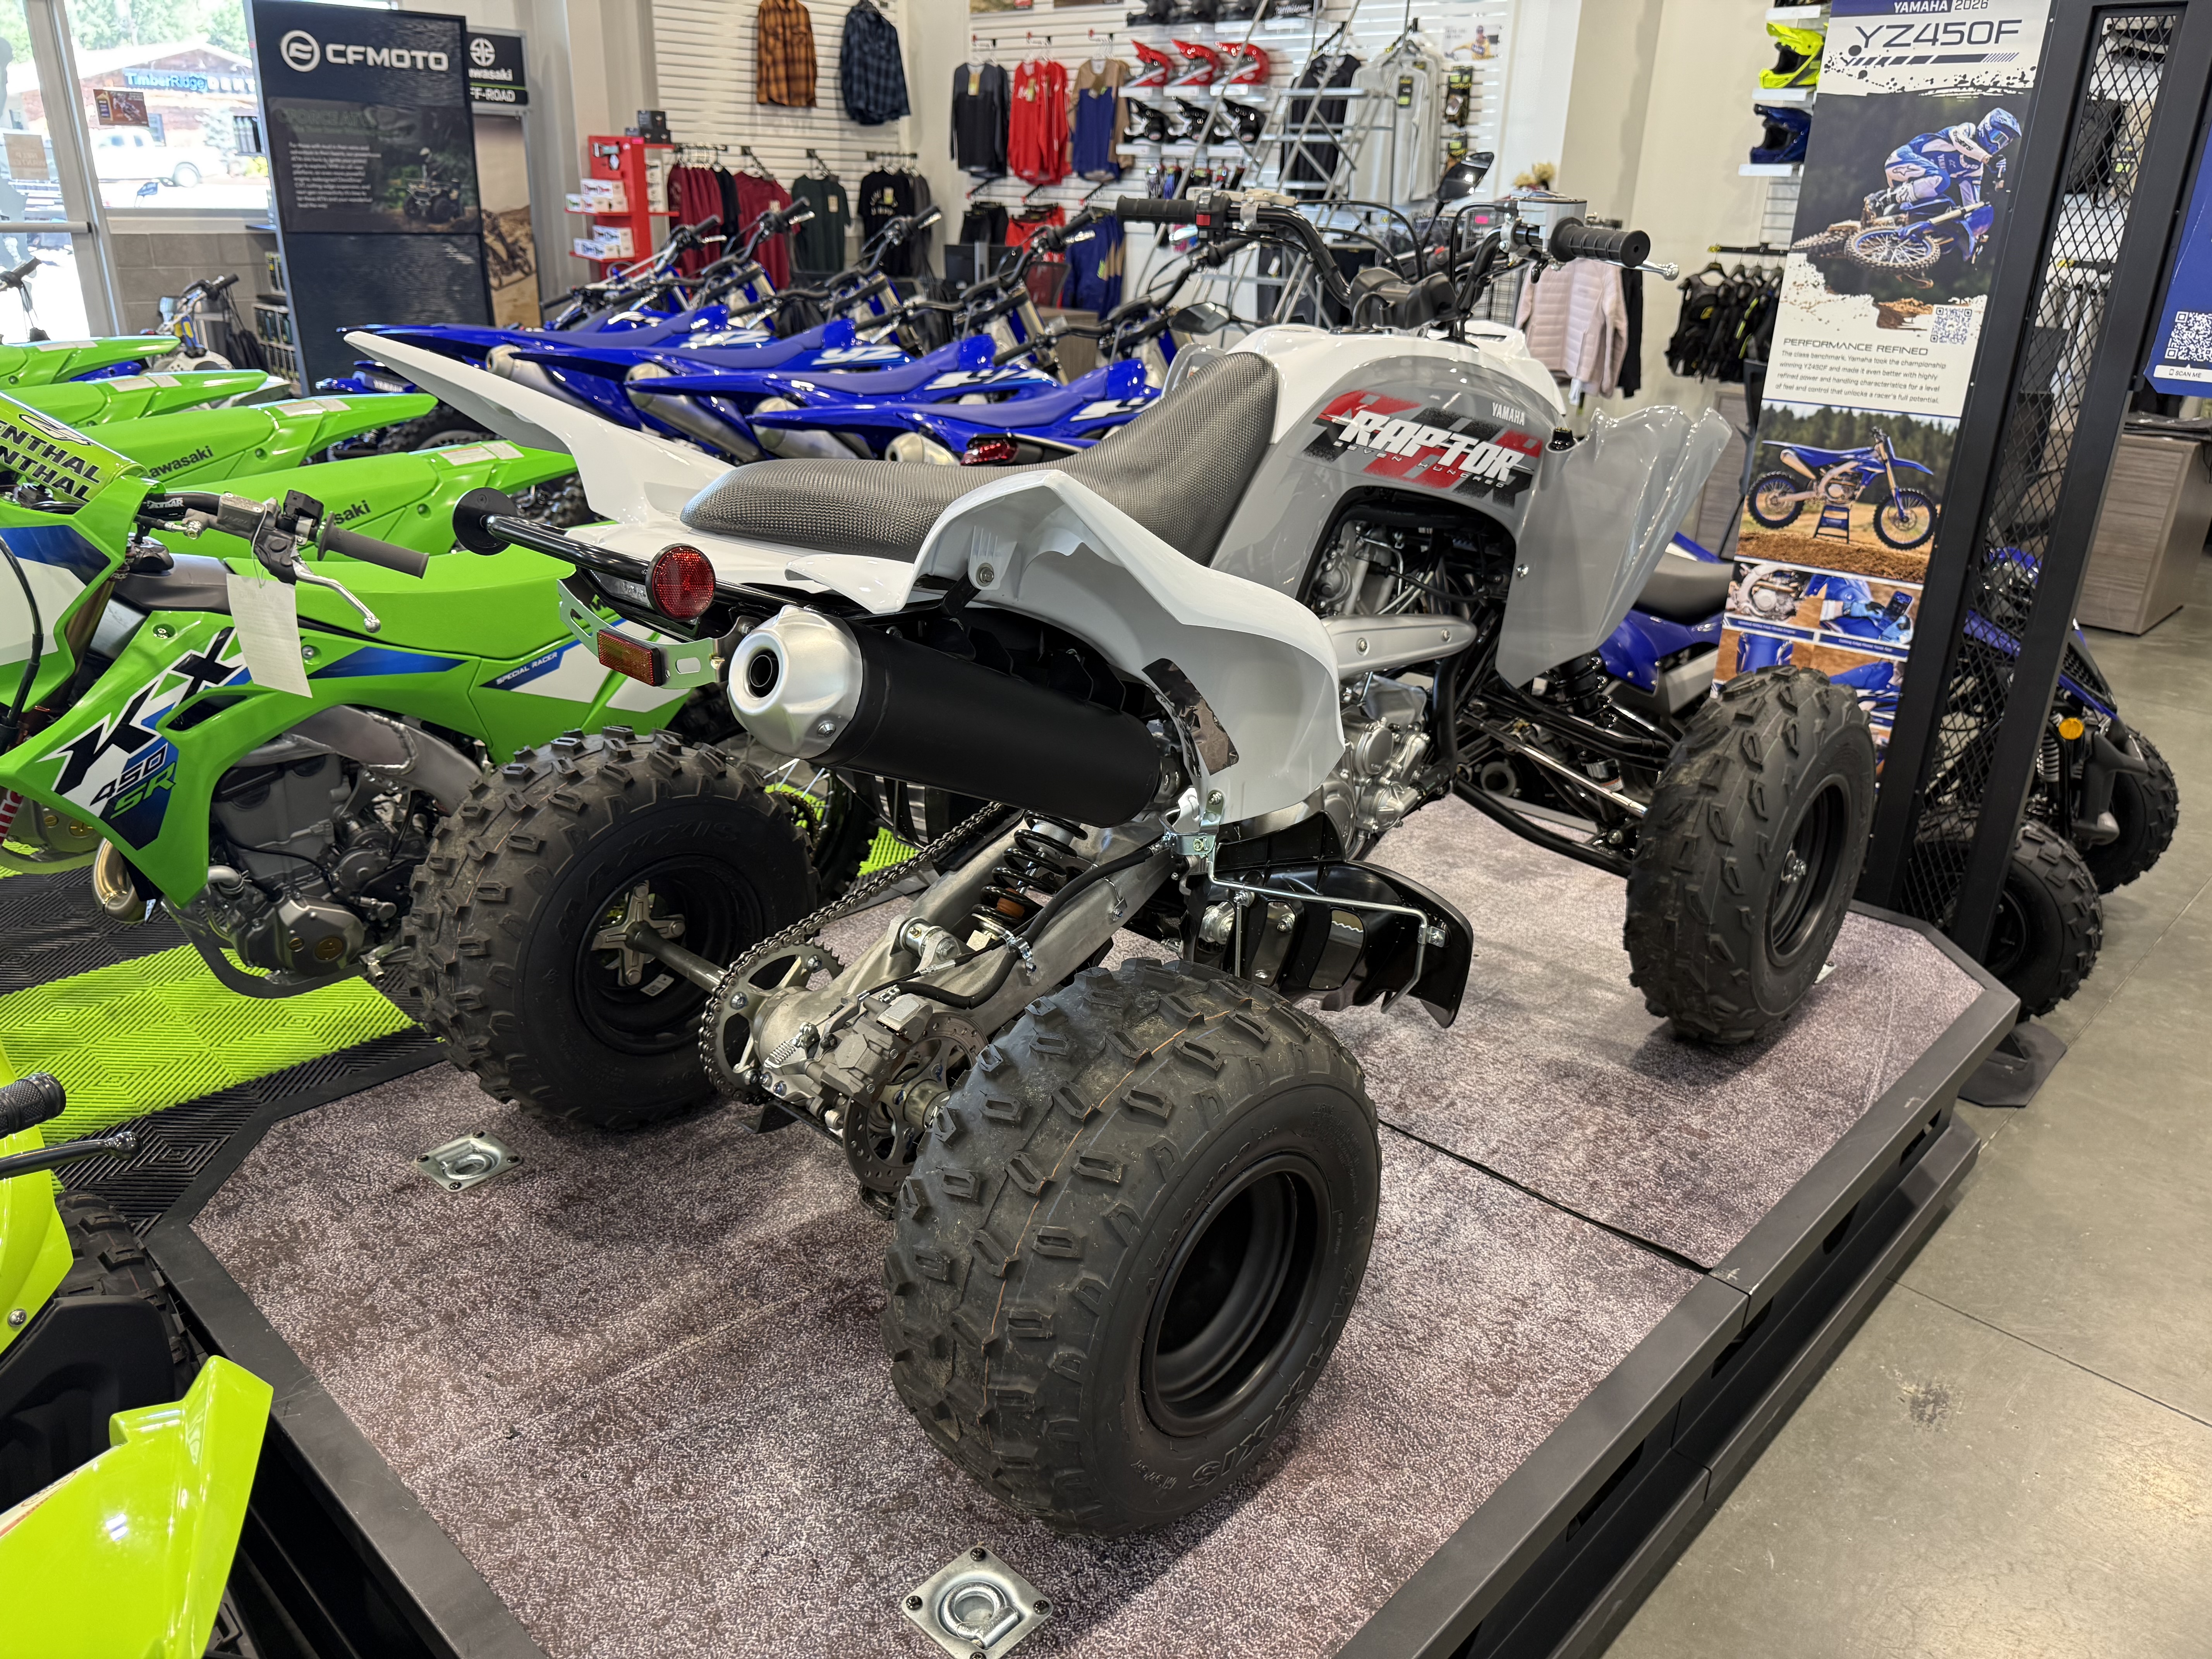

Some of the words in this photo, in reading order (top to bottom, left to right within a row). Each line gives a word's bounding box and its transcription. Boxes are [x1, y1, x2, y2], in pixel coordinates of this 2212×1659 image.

[1894, 0, 1948, 13] YAMAHA
[1954, 0, 1988, 10] 2026
[1855, 19, 2022, 48] YZ450F
[326, 43, 448, 71] CFMOTO
[469, 67, 513, 81] wasaki
[1783, 338, 1872, 352] PERFORMANCE
[1876, 344, 1928, 356] REFINED
[1779, 361, 1802, 369] winning
[1918, 372, 1938, 381] highly
[1848, 355, 1872, 363] Yamaha
[1901, 360, 1946, 369] championship
[1832, 377, 1859, 386] handling
[1860, 379, 1907, 389] characteristics
[1844, 389, 1868, 397] unlocks
[1492, 402, 1525, 426] YAMAHA
[1338, 410, 1525, 483] RAPTOR
[149, 445, 214, 478] awasaki
[1333, 440, 1403, 462] SEVEN
[1417, 462, 1506, 488] HUNDRED
[496, 666, 530, 685] SPECIAL
[532, 652, 558, 668] RACER
[89, 742, 168, 807] 450
[110, 762, 177, 820] SR
[1188, 1263, 1357, 1490] MAXXIS
